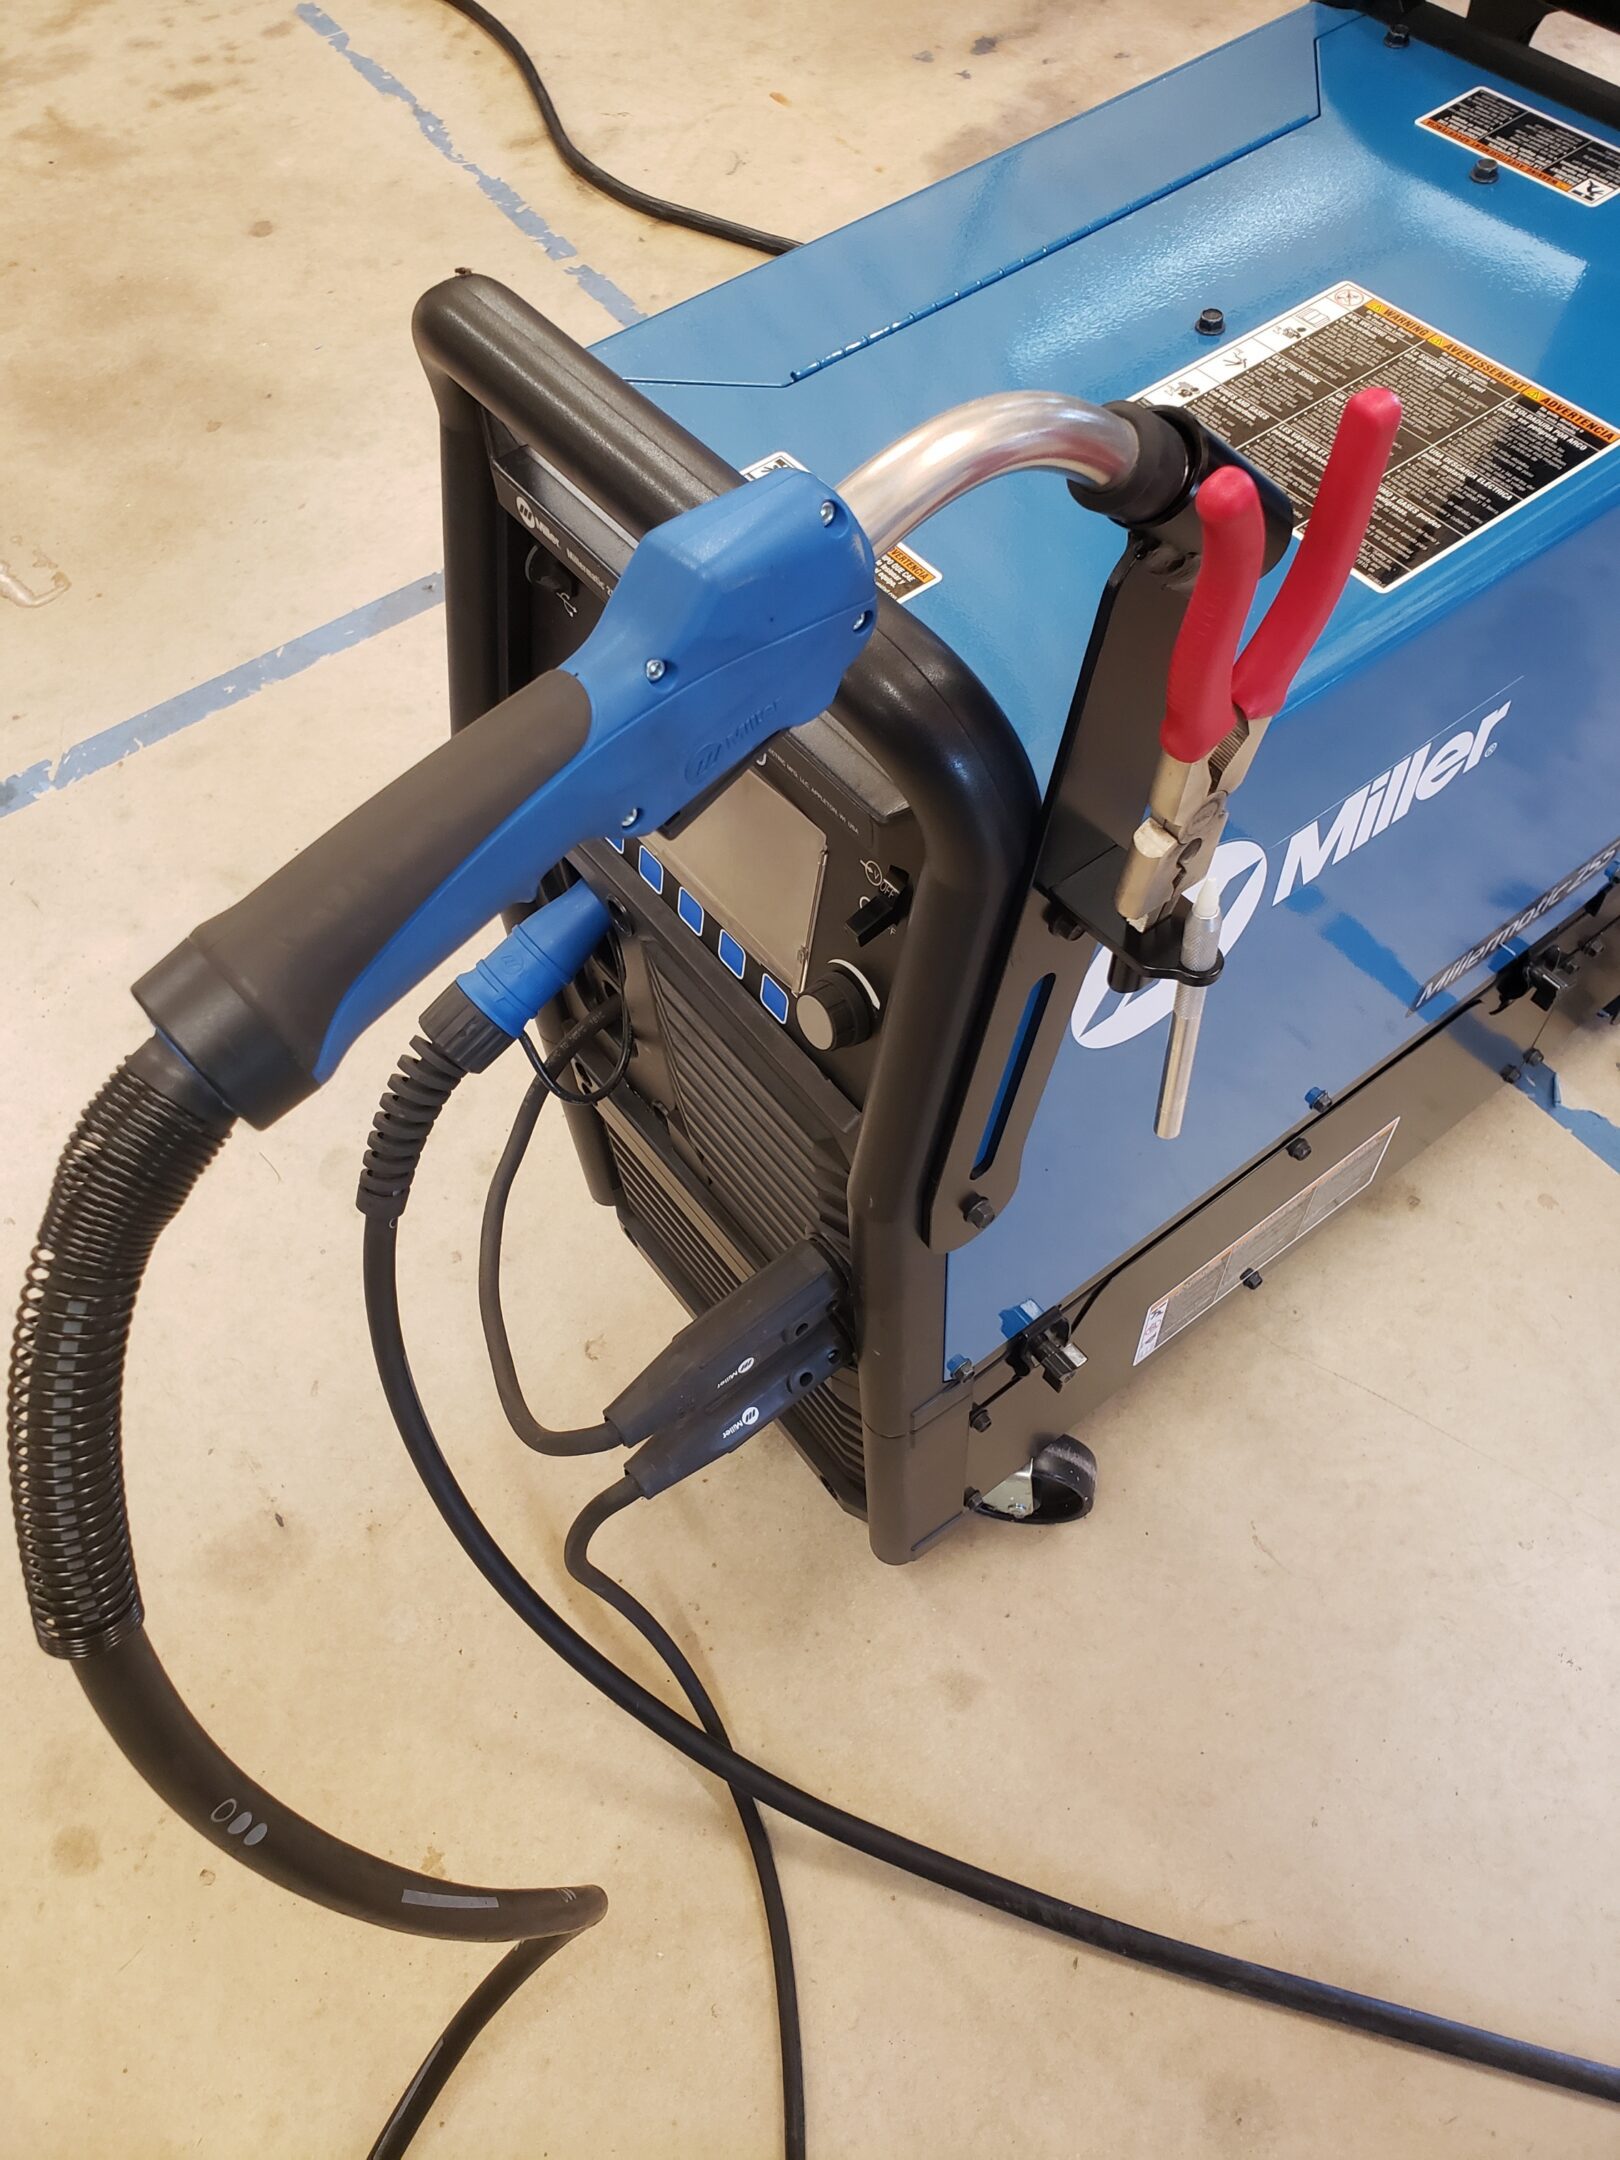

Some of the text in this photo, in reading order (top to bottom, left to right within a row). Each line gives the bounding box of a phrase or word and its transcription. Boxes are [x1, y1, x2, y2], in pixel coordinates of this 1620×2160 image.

[1271, 354, 1300, 372] ELECTRIC
[1298, 370, 1320, 384] SHOCK
[1383, 308, 1429, 336] WARNING
[1444, 343, 1526, 390] AVERTISSEMENT
[1540, 396, 1615, 440] ADVERTENCIA
[1418, 353, 1448, 371] SOUDAGE
[1469, 383, 1485, 393] peut
[1214, 385, 1238, 400] FUMES
[1234, 397, 1250, 408] AND
[1247, 405, 1270, 420] GASES
[1278, 424, 1292, 434] LES
[1289, 432, 1320, 451] VAPEURS
[1497, 406, 1559, 443] puede ser peligrosa.
[1513, 407, 1554, 431] SOLDADURA
[1552, 429, 1568, 440] POR
[1566, 437, 1587, 450] ARCO
[1428, 448, 1444, 459] UNA
[1441, 457, 1478, 479] DESCARGA
[1475, 477, 1514, 500] ELÉCTRICA
[1394, 498, 1420, 514] GASES
[1416, 512, 1442, 528] pueden
[534, 516, 560, 549] Miller
[891, 548, 929, 581] VERTENCIA
[1272, 700, 1512, 907] Miller
[1415, 879, 1573, 1009] Millermatic
[716, 1370, 738, 1390] Miller
[722, 1419, 744, 1439] Miller
